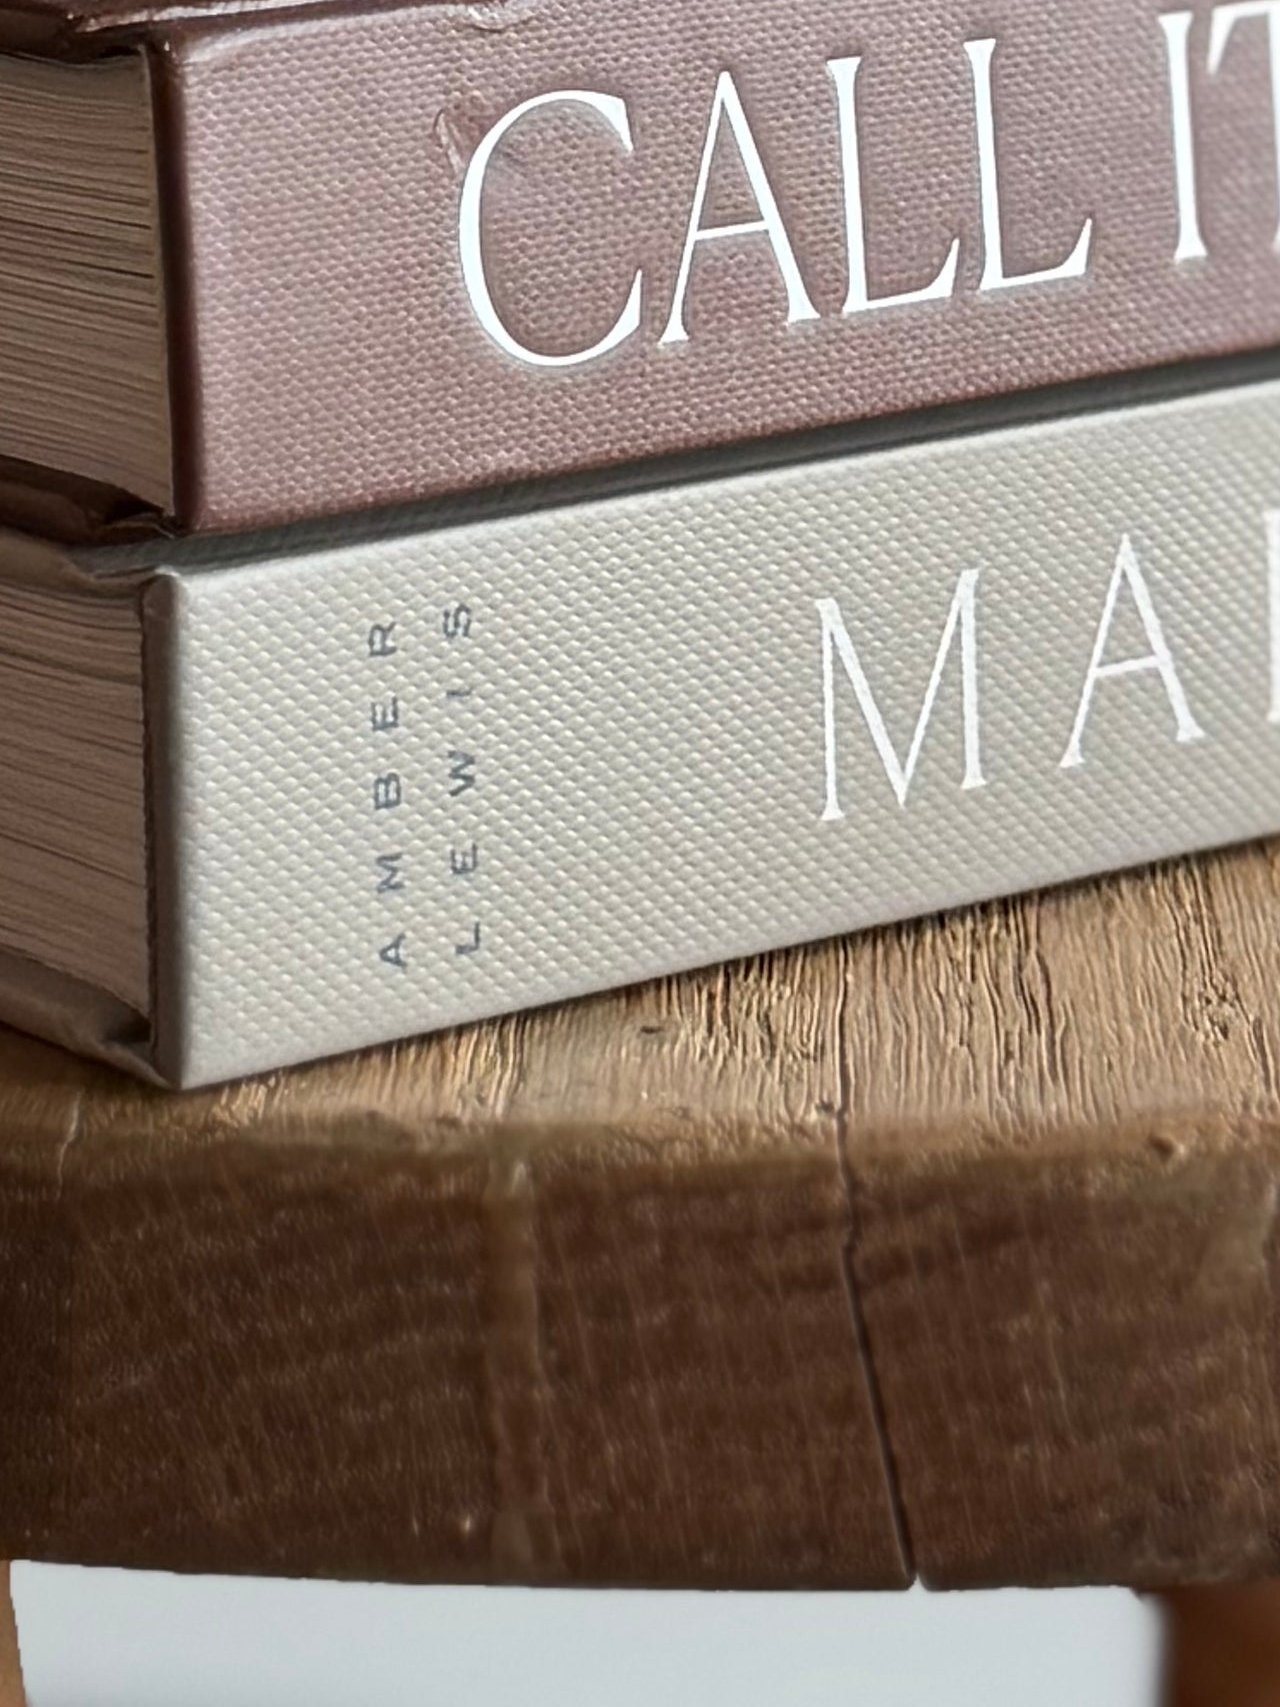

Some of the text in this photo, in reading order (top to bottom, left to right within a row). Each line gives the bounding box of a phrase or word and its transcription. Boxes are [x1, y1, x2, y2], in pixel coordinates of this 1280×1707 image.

[458, 37, 1094, 368] CALL
[367, 621, 407, 968] AMBER
[442, 602, 481, 955] LEWIS
